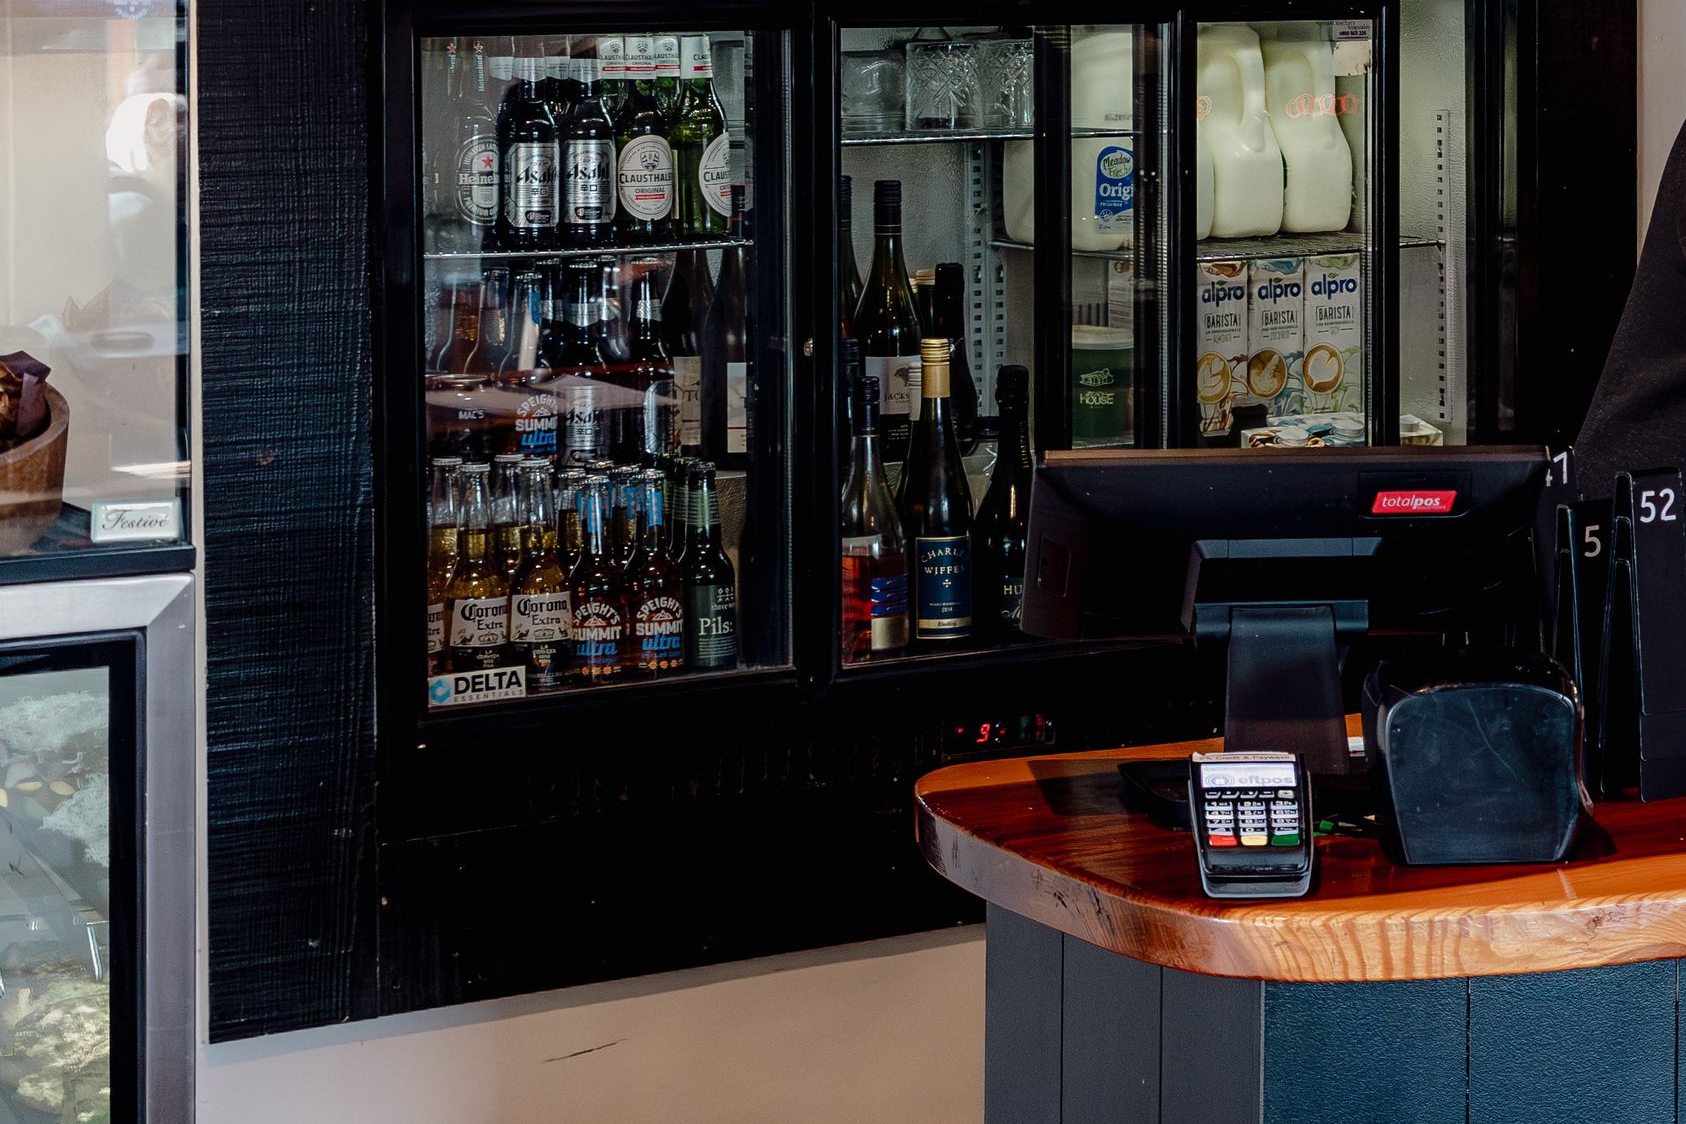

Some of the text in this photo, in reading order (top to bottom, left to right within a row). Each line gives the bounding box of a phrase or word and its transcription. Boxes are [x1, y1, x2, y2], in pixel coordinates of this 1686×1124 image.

[619, 172, 672, 184] CLAUSTHALE
[1202, 279, 1245, 307] alpro
[1257, 277, 1301, 304] alpro
[1311, 273, 1358, 300] alpro
[1206, 313, 1238, 328] BARISTA
[1264, 310, 1295, 326] BARISTA
[1318, 306, 1351, 321] BARISTA
[515, 416, 558, 432] SUMMI
[1382, 495, 1441, 511] totalpos
[1639, 488, 1677, 523] 52
[461, 603, 507, 622] Coron
[517, 597, 568, 617] Corona
[531, 614, 561, 626] Extra
[573, 626, 622, 641] SUMMIT
[454, 670, 522, 695] DELTA
[454, 689, 524, 703] ESSENTIALS
[1238, 775, 1293, 786] eftpos
